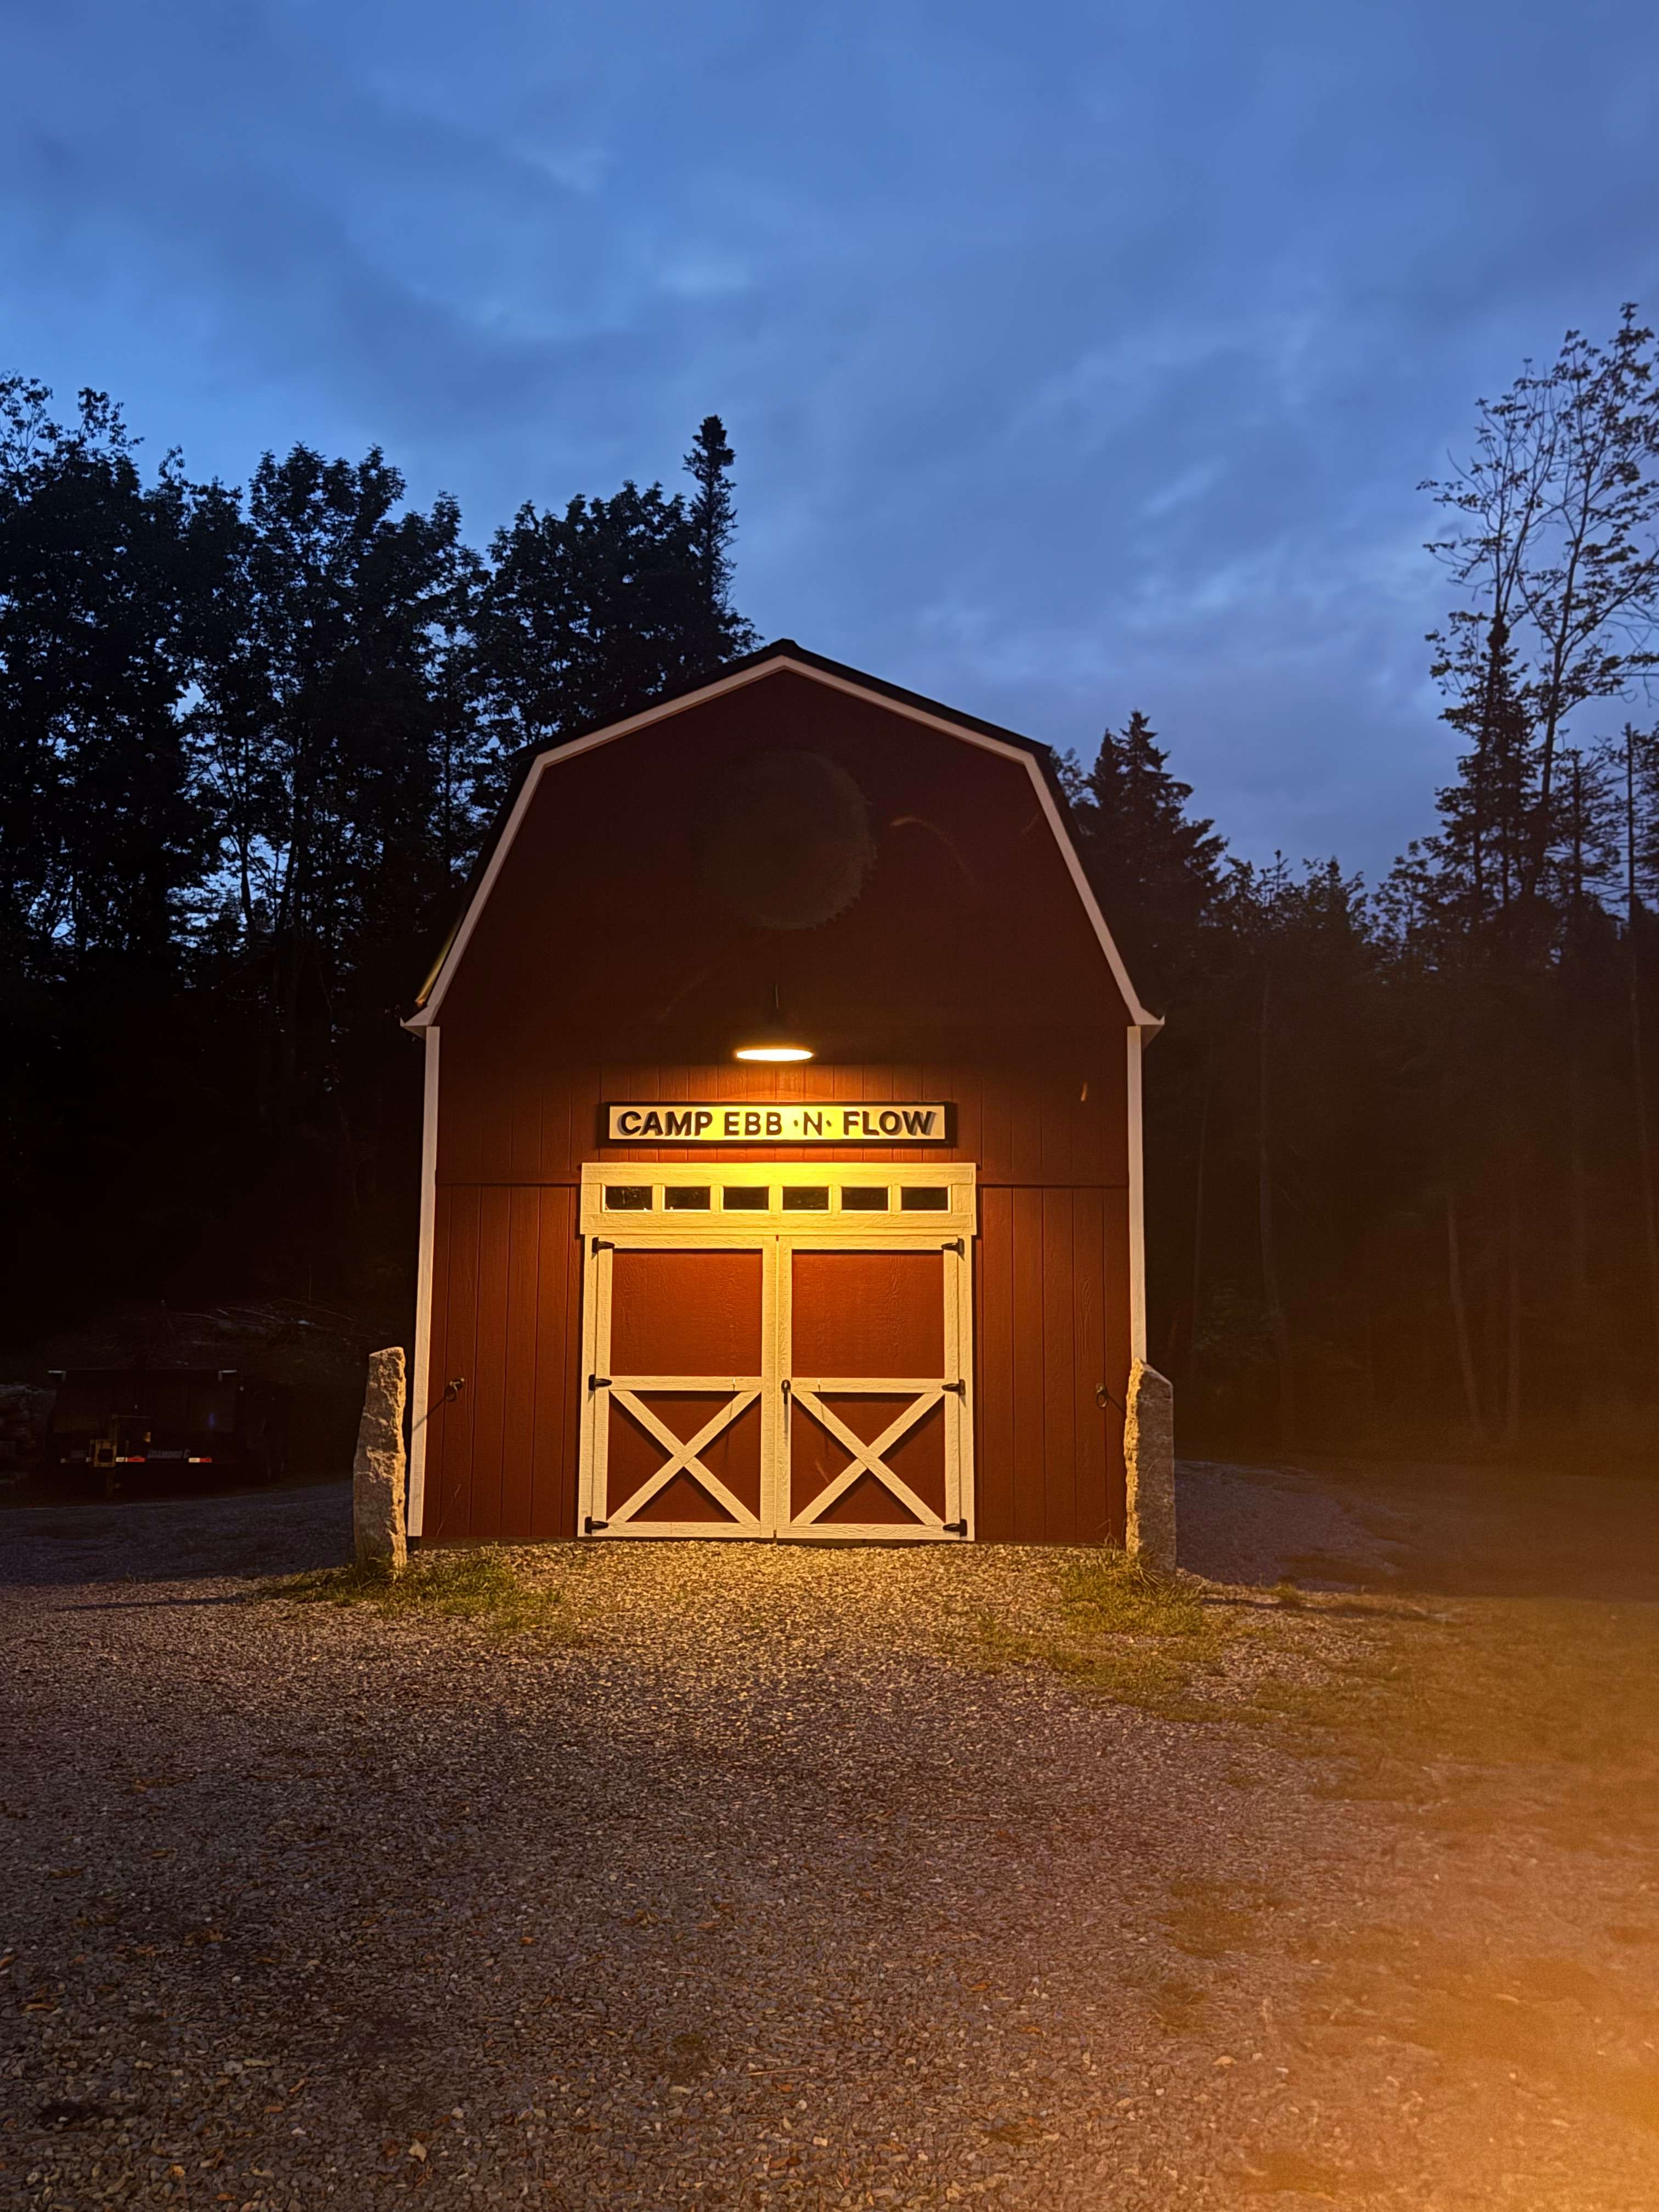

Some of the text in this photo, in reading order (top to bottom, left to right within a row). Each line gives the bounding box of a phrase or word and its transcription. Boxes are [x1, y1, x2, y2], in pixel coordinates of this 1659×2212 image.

[618, 1111, 713, 1136] CAMP
[724, 1111, 782, 1136] EBB
[843, 1110, 936, 1136] FLOW
